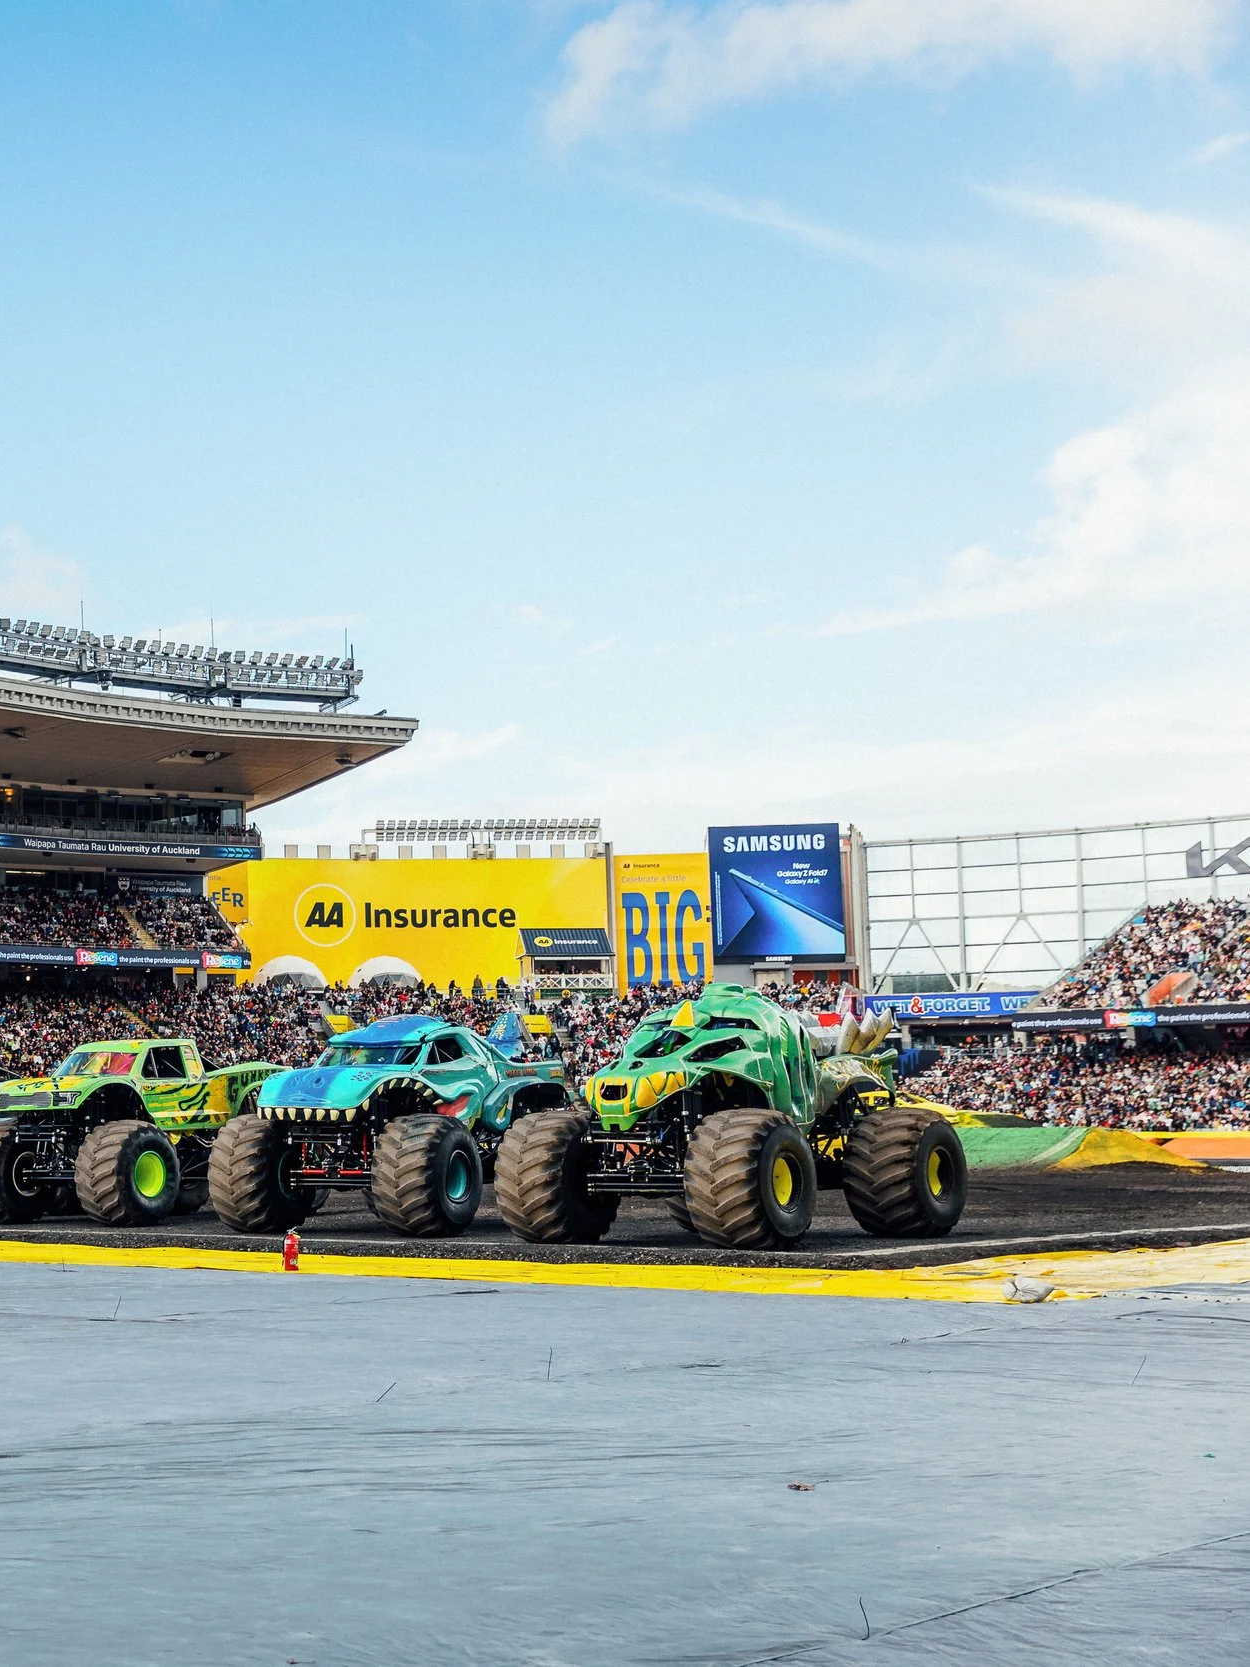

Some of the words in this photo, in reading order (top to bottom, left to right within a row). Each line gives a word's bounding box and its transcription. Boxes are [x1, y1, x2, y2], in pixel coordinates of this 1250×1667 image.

[24, 838, 56, 850] Waipapa
[58, 840, 89, 850] Taumata
[91, 842, 107, 851] Rau
[108, 843, 150, 855] University
[152, 845, 161, 854] of
[162, 846, 200, 855] Auckland
[723, 834, 825, 853] SAMSUNG
[776, 870, 802, 878] Galaxy
[809, 869, 828, 877] Fold7
[305, 902, 344, 928] AA
[365, 903, 516, 928] Insurance
[621, 889, 705, 988] BIG
[6, 952, 21, 962] paint
[20, 952, 30, 961] the
[29, 953, 63, 962] professionals
[79, 952, 115, 965] Resene
[119, 956, 129, 964] the
[129, 956, 144, 965] paint
[143, 956, 153, 964] the
[153, 956, 189, 965] professionals
[206, 954, 239, 966] Resene
[1017, 1019, 1034, 1029] paint
[1034, 1018, 1045, 1027] the
[1046, 1018, 1090, 1028] professionals
[1157, 1014, 1169, 1022] the
[1169, 1013, 1188, 1023] paint
[1188, 1013, 1201, 1021] the
